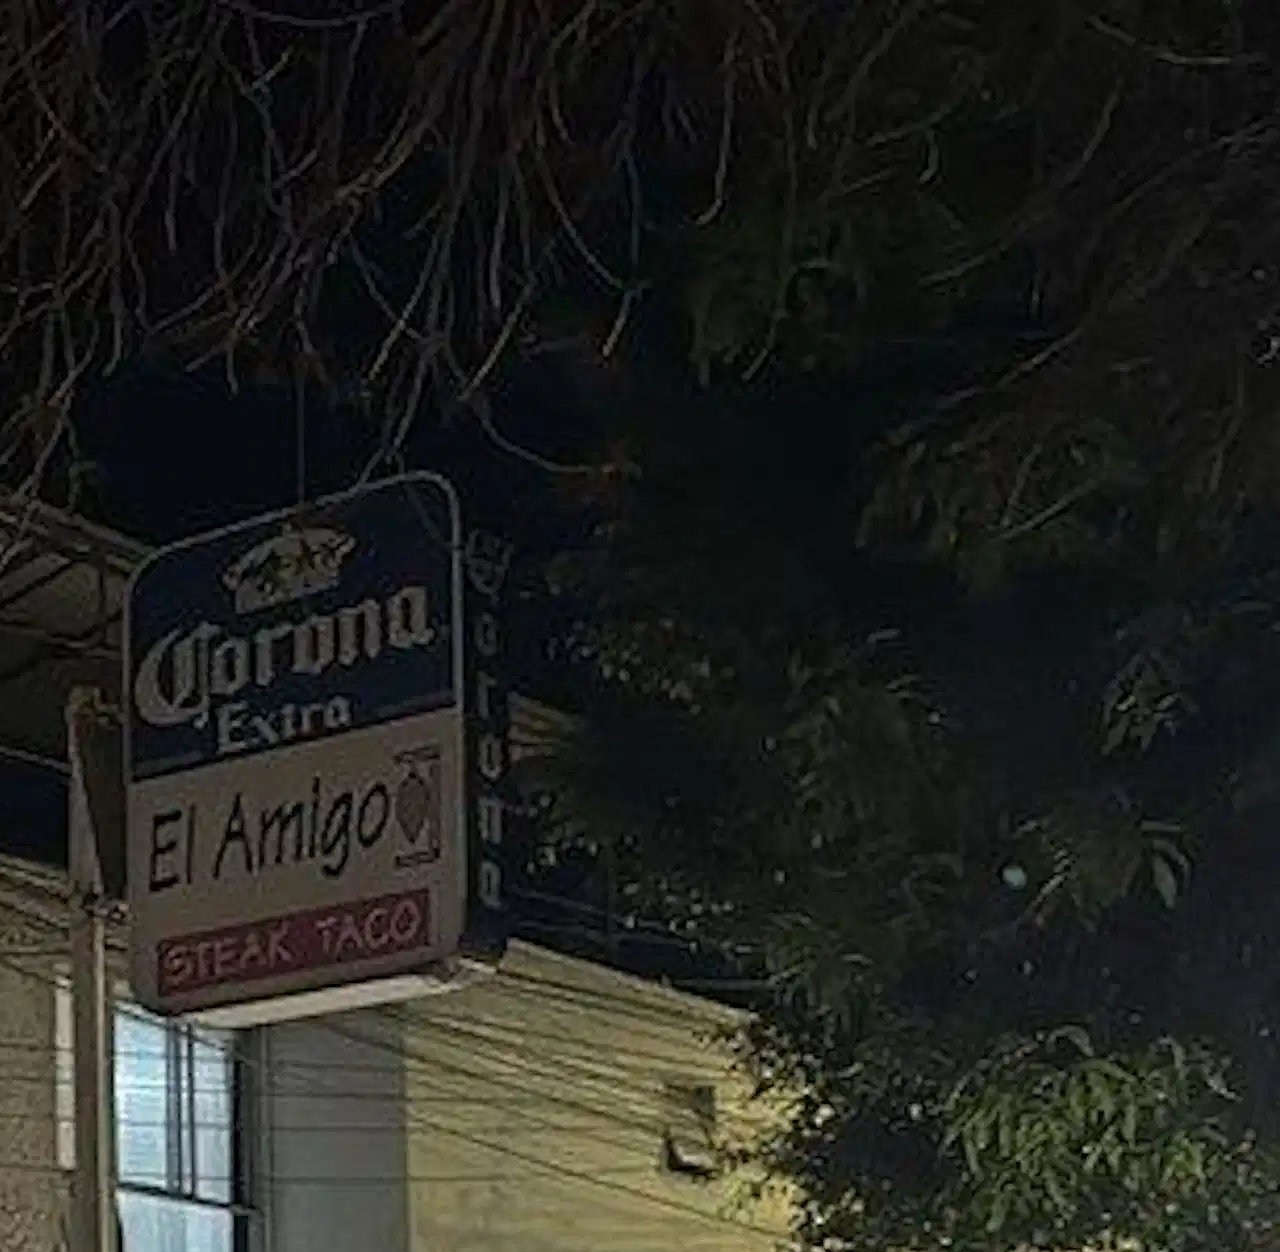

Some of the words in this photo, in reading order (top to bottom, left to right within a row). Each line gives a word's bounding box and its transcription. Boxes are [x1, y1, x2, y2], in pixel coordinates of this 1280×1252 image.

[135, 586, 436, 728] Corona
[214, 695, 354, 755] Extra
[147, 808, 193, 893] El
[212, 776, 390, 877] Amigo
[164, 919, 293, 984] STEAK
[319, 900, 422, 954] TACO
